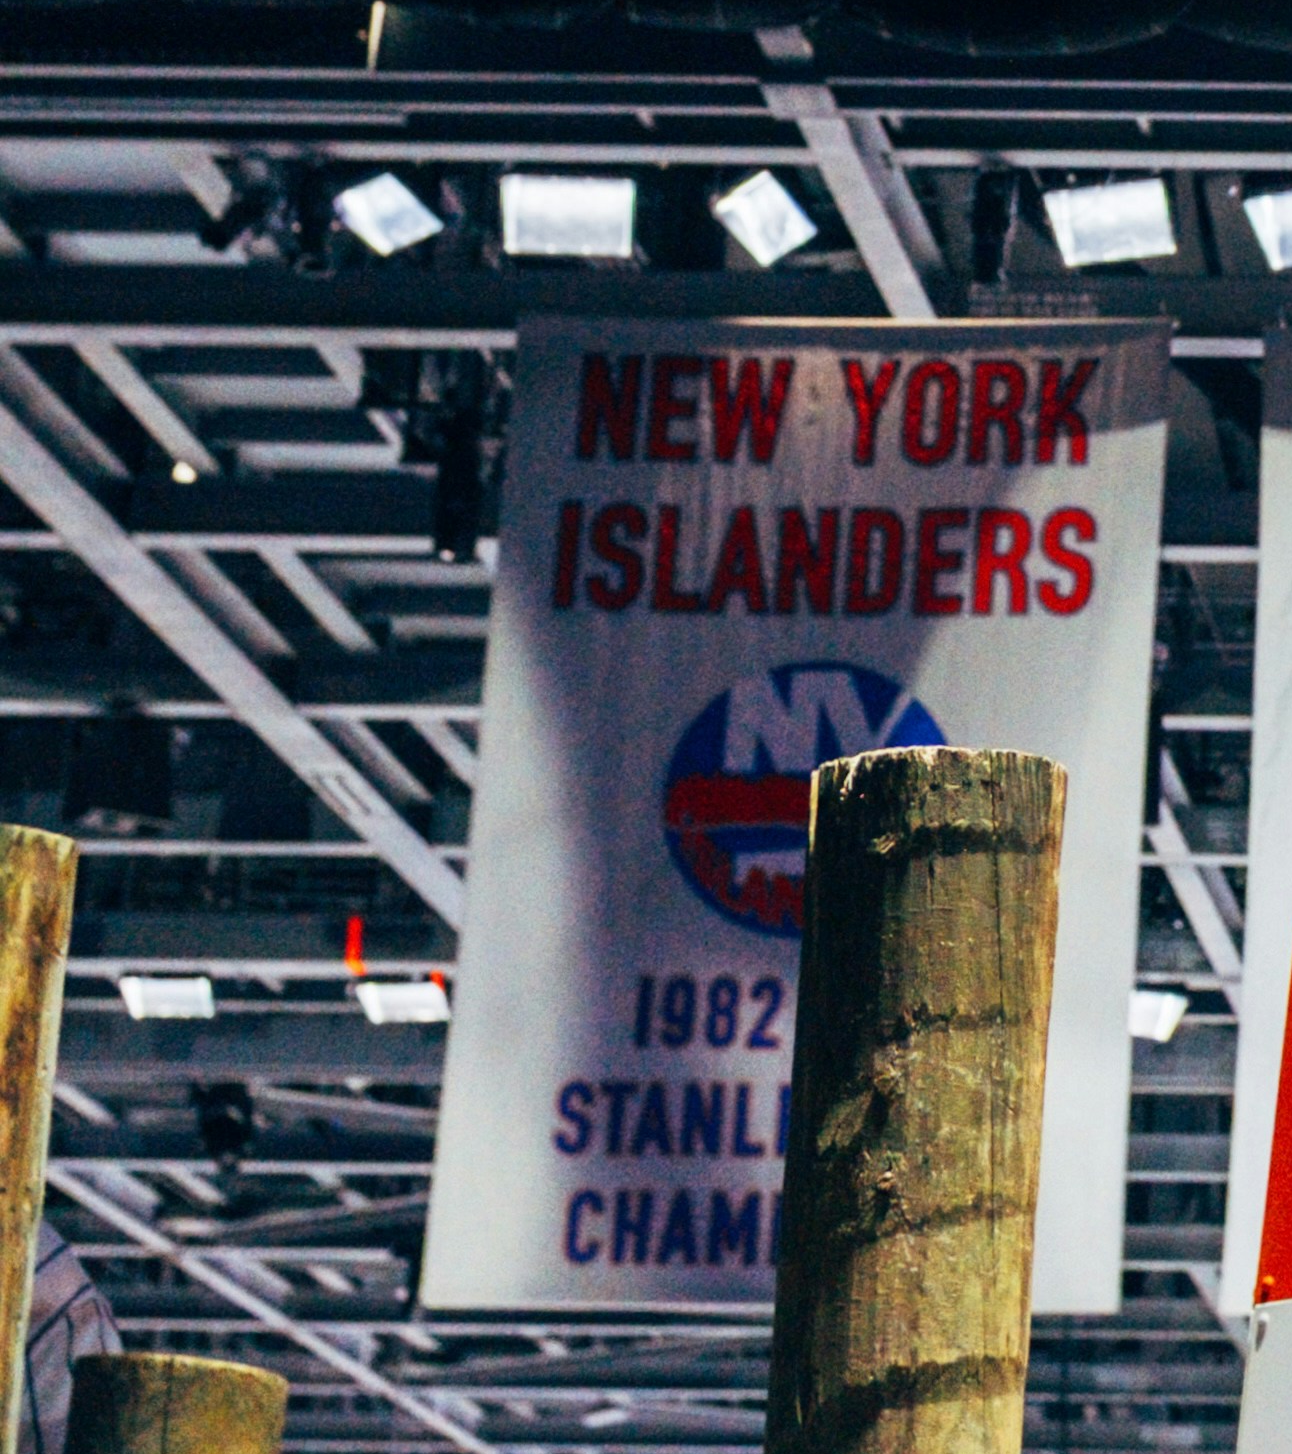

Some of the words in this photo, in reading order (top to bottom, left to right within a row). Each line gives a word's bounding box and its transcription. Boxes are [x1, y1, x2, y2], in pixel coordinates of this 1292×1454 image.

[575, 353, 796, 464] NEW
[842, 356, 1100, 467] YORK
[551, 499, 1098, 617] ISLANDERS
[634, 974, 785, 1049] 1982
[554, 1078, 793, 1158] STANL
